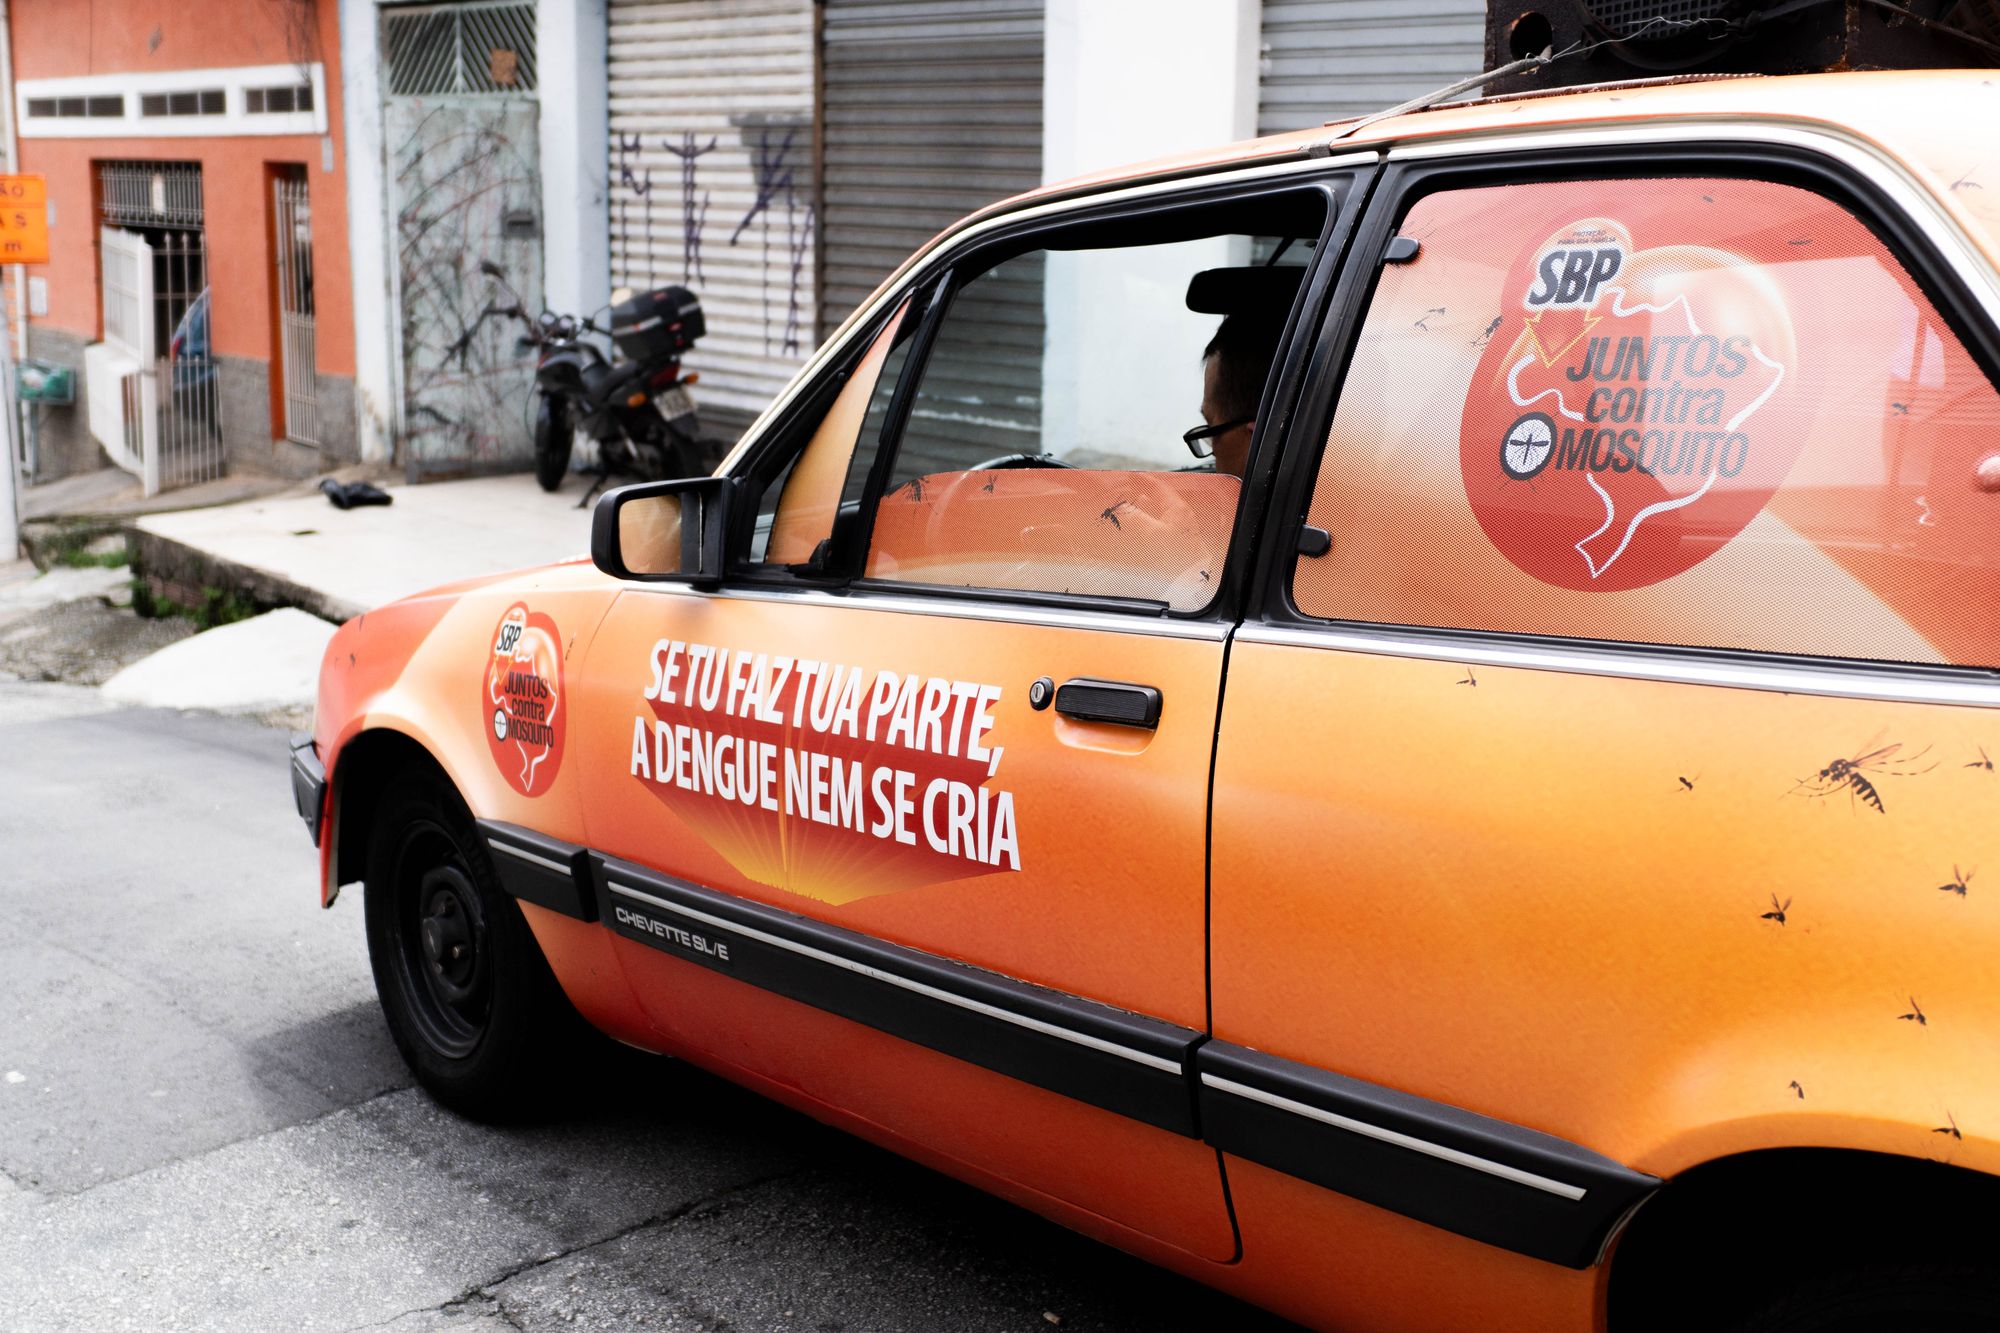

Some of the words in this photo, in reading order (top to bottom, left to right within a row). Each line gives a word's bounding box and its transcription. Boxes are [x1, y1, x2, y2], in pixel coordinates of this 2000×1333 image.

[1528, 248, 1622, 305] SBP
[1566, 335, 1751, 382] JUNTOS
[1586, 380, 1726, 424] contra
[1555, 428, 1750, 478] MOSQUITO
[497, 624, 522, 651] SBP
[505, 671, 548, 699] JUNTOS
[644, 638, 687, 704] SE
[684, 643, 729, 712] TU
[726, 651, 794, 725] FAZ
[793, 659, 864, 738] TUA
[866, 670, 1005, 777] PARTE,
[511, 697, 545, 721] contra
[507, 719, 554, 748] MOSQUITO
[631, 715, 651, 779] A
[655, 720, 778, 812] DENGUE
[785, 747, 864, 833] NEM
[871, 766, 916, 846] SE
[923, 777, 1021, 872] CRIA
[616, 907, 691, 947] CHEVETTE
[692, 934, 729, 960] SL/E
